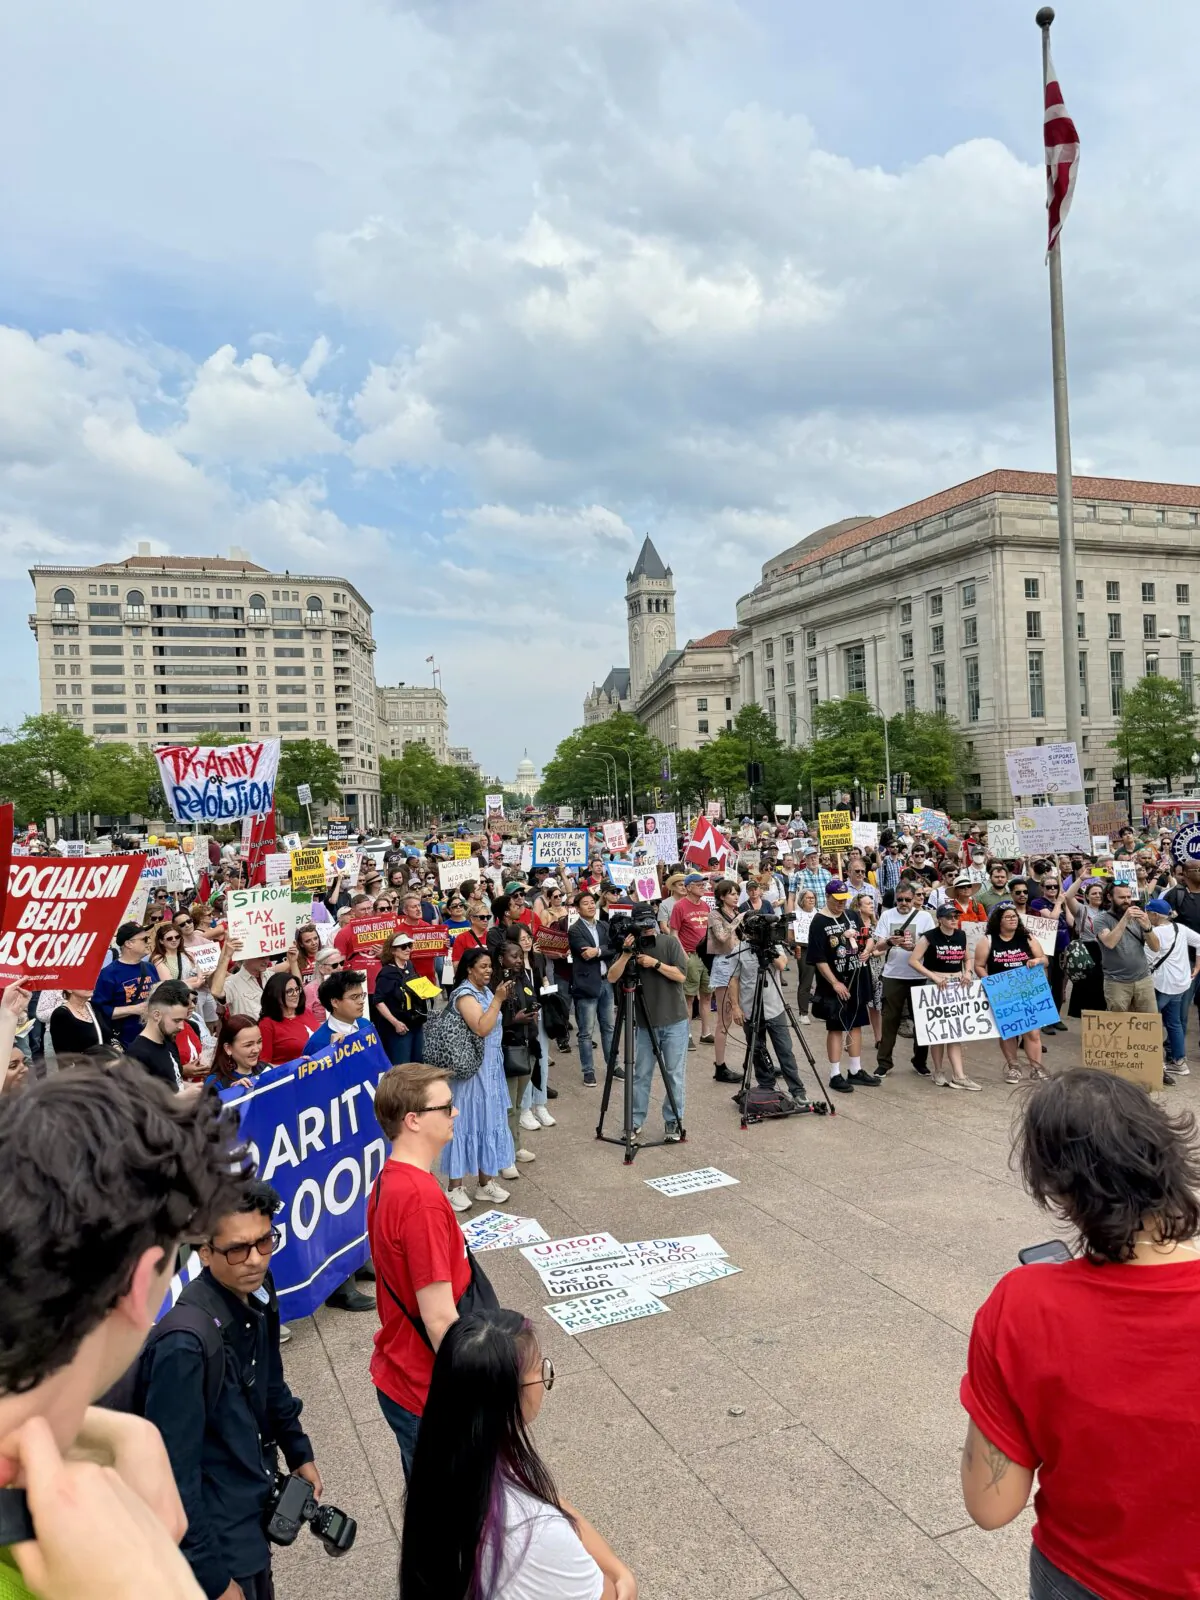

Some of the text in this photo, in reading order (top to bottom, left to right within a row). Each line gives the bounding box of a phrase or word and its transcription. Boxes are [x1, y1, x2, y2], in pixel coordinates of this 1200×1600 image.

[822, 822, 850, 831] TRUMP'S
[544, 832, 567, 840] PROTEST
[822, 838, 851, 846] AGENDA!
[994, 834, 1015, 847] And
[542, 840, 562, 848] KEEPS
[540, 847, 581, 857] FASCISTS
[296, 856, 320, 865] UNIDO
[442, 860, 472, 868] WORKERS
[232, 888, 290, 908] STRONG
[17, 900, 88, 931] BEATS
[246, 908, 274, 926] TAX
[262, 922, 286, 937] THE
[354, 924, 372, 934] UNION
[372, 920, 396, 930] BUSTING
[359, 932, 382, 942] DOESN'T
[426, 932, 447, 940] BUSTING
[0, 931, 98, 968] ASCISM!
[260, 938, 286, 953] RICH
[986, 968, 1024, 986] SUPER
[918, 982, 988, 1008] AMERICA
[1021, 982, 1048, 1000] RACIST
[974, 1000, 990, 1014] DO
[996, 1000, 1033, 1018] SEXIST
[1024, 998, 1054, 1017] NAZI
[926, 1014, 992, 1042] KINGS
[1000, 1016, 1038, 1036] POTUS
[1082, 1015, 1157, 1036] They fear
[1084, 1034, 1158, 1052] LOVE because
[298, 1055, 333, 1080] IFPTE
[334, 1040, 364, 1064] LOCAL
[1084, 1050, 1092, 1058] it
[682, 1182, 702, 1190] THE
[468, 1233, 498, 1248] NEED
[624, 1242, 648, 1252] LE
[628, 1246, 696, 1258] HAS NO
[550, 1259, 634, 1276] Occidental
[548, 1277, 578, 1286] has
[565, 1289, 629, 1310] Stand
[565, 1300, 660, 1328] Restaurant
